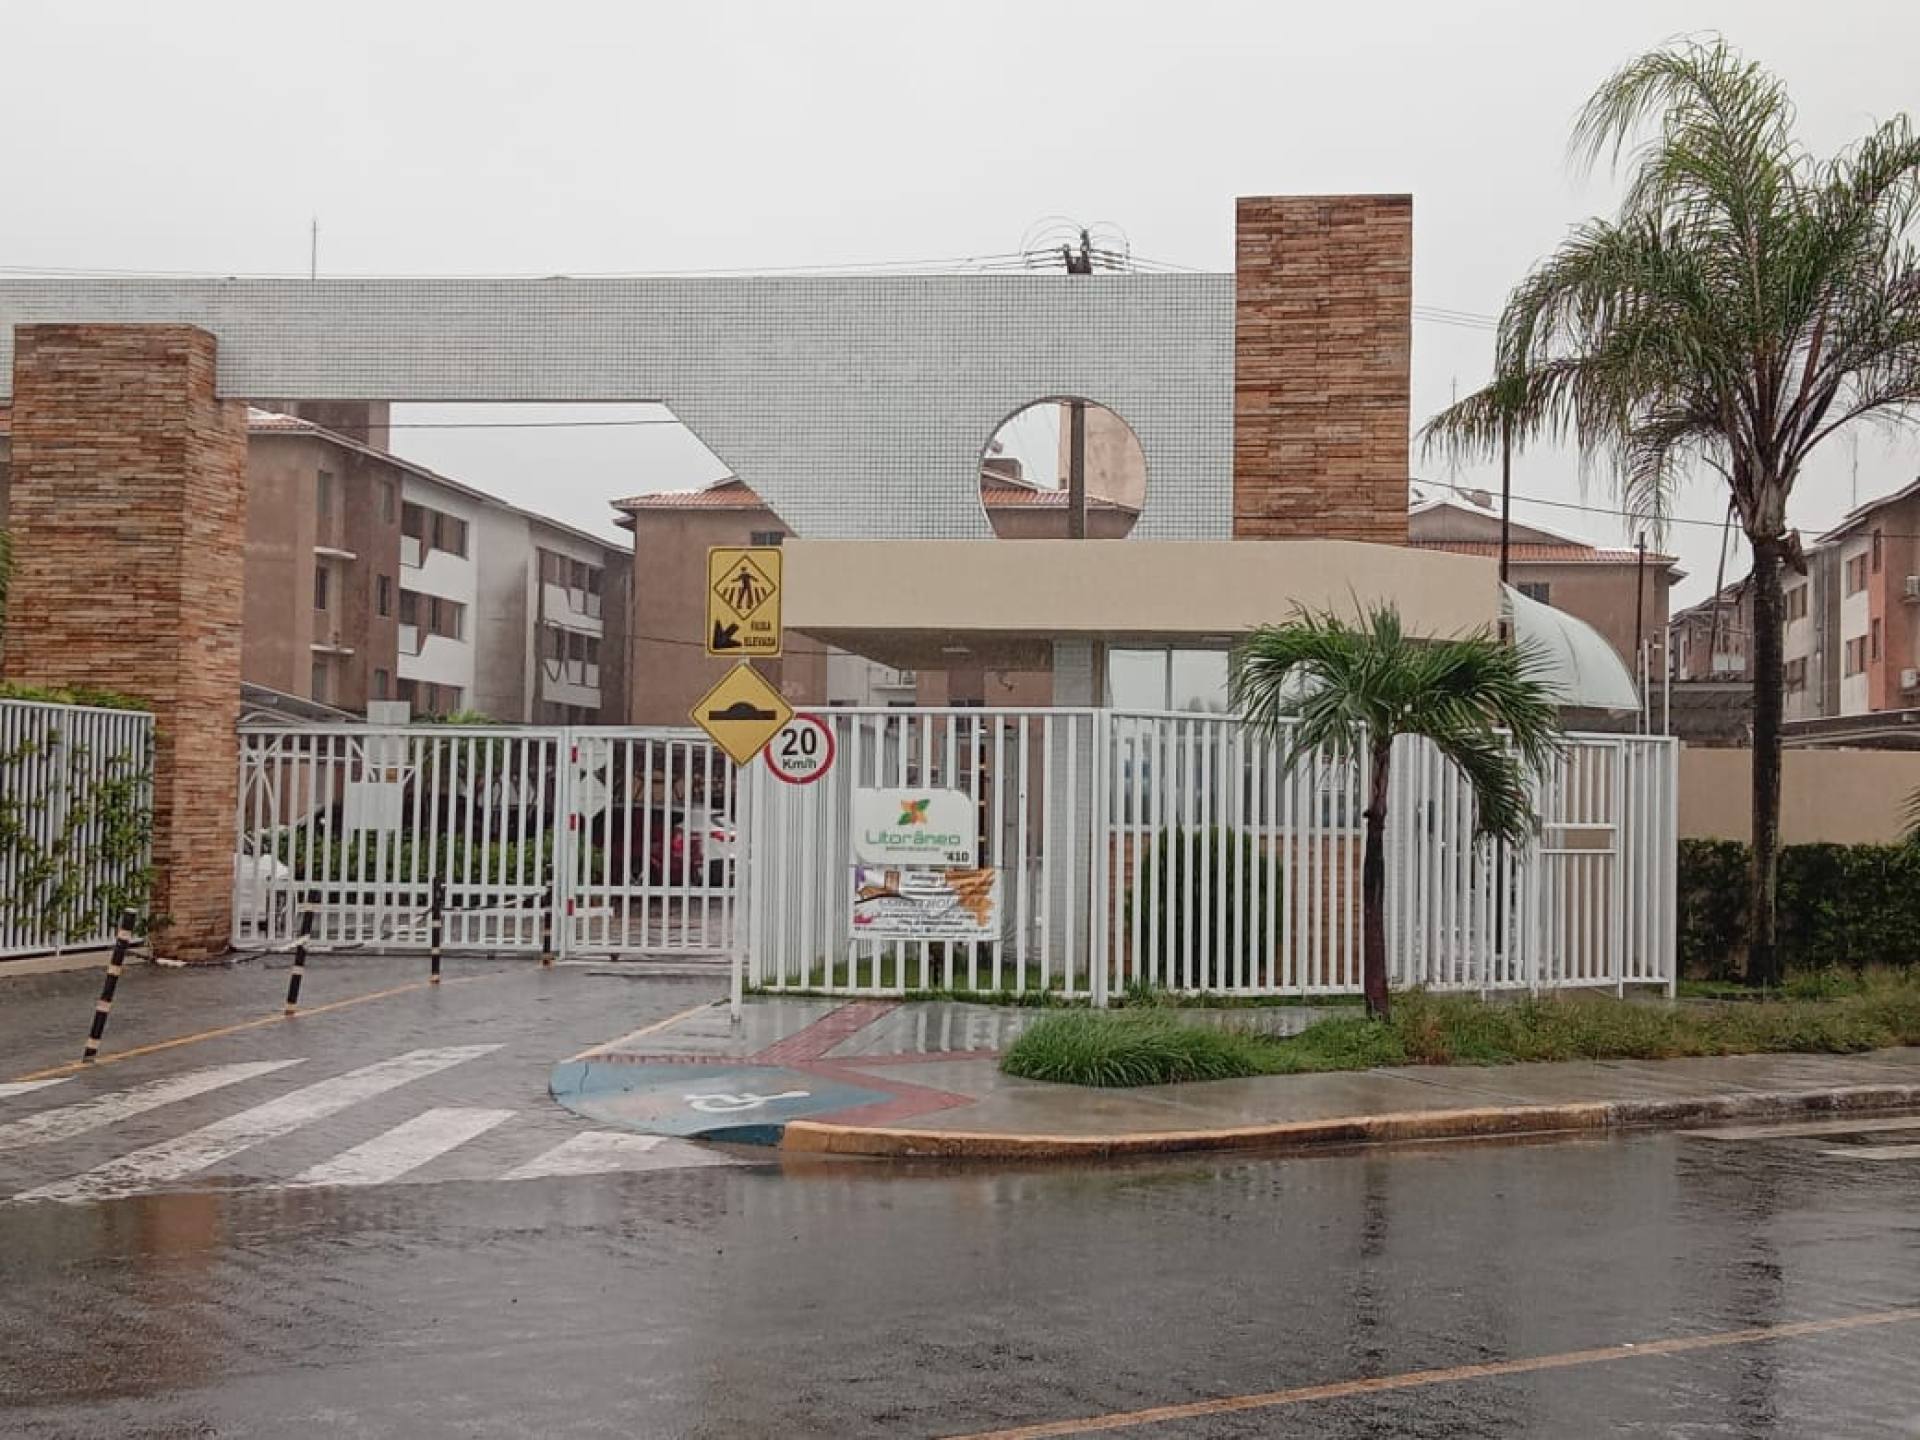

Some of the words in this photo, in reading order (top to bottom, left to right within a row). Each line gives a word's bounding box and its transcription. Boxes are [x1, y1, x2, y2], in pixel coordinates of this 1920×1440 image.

[781, 727, 817, 756] 20
[782, 758, 817, 769] Km/h
[866, 830, 961, 845] Litorâneo
